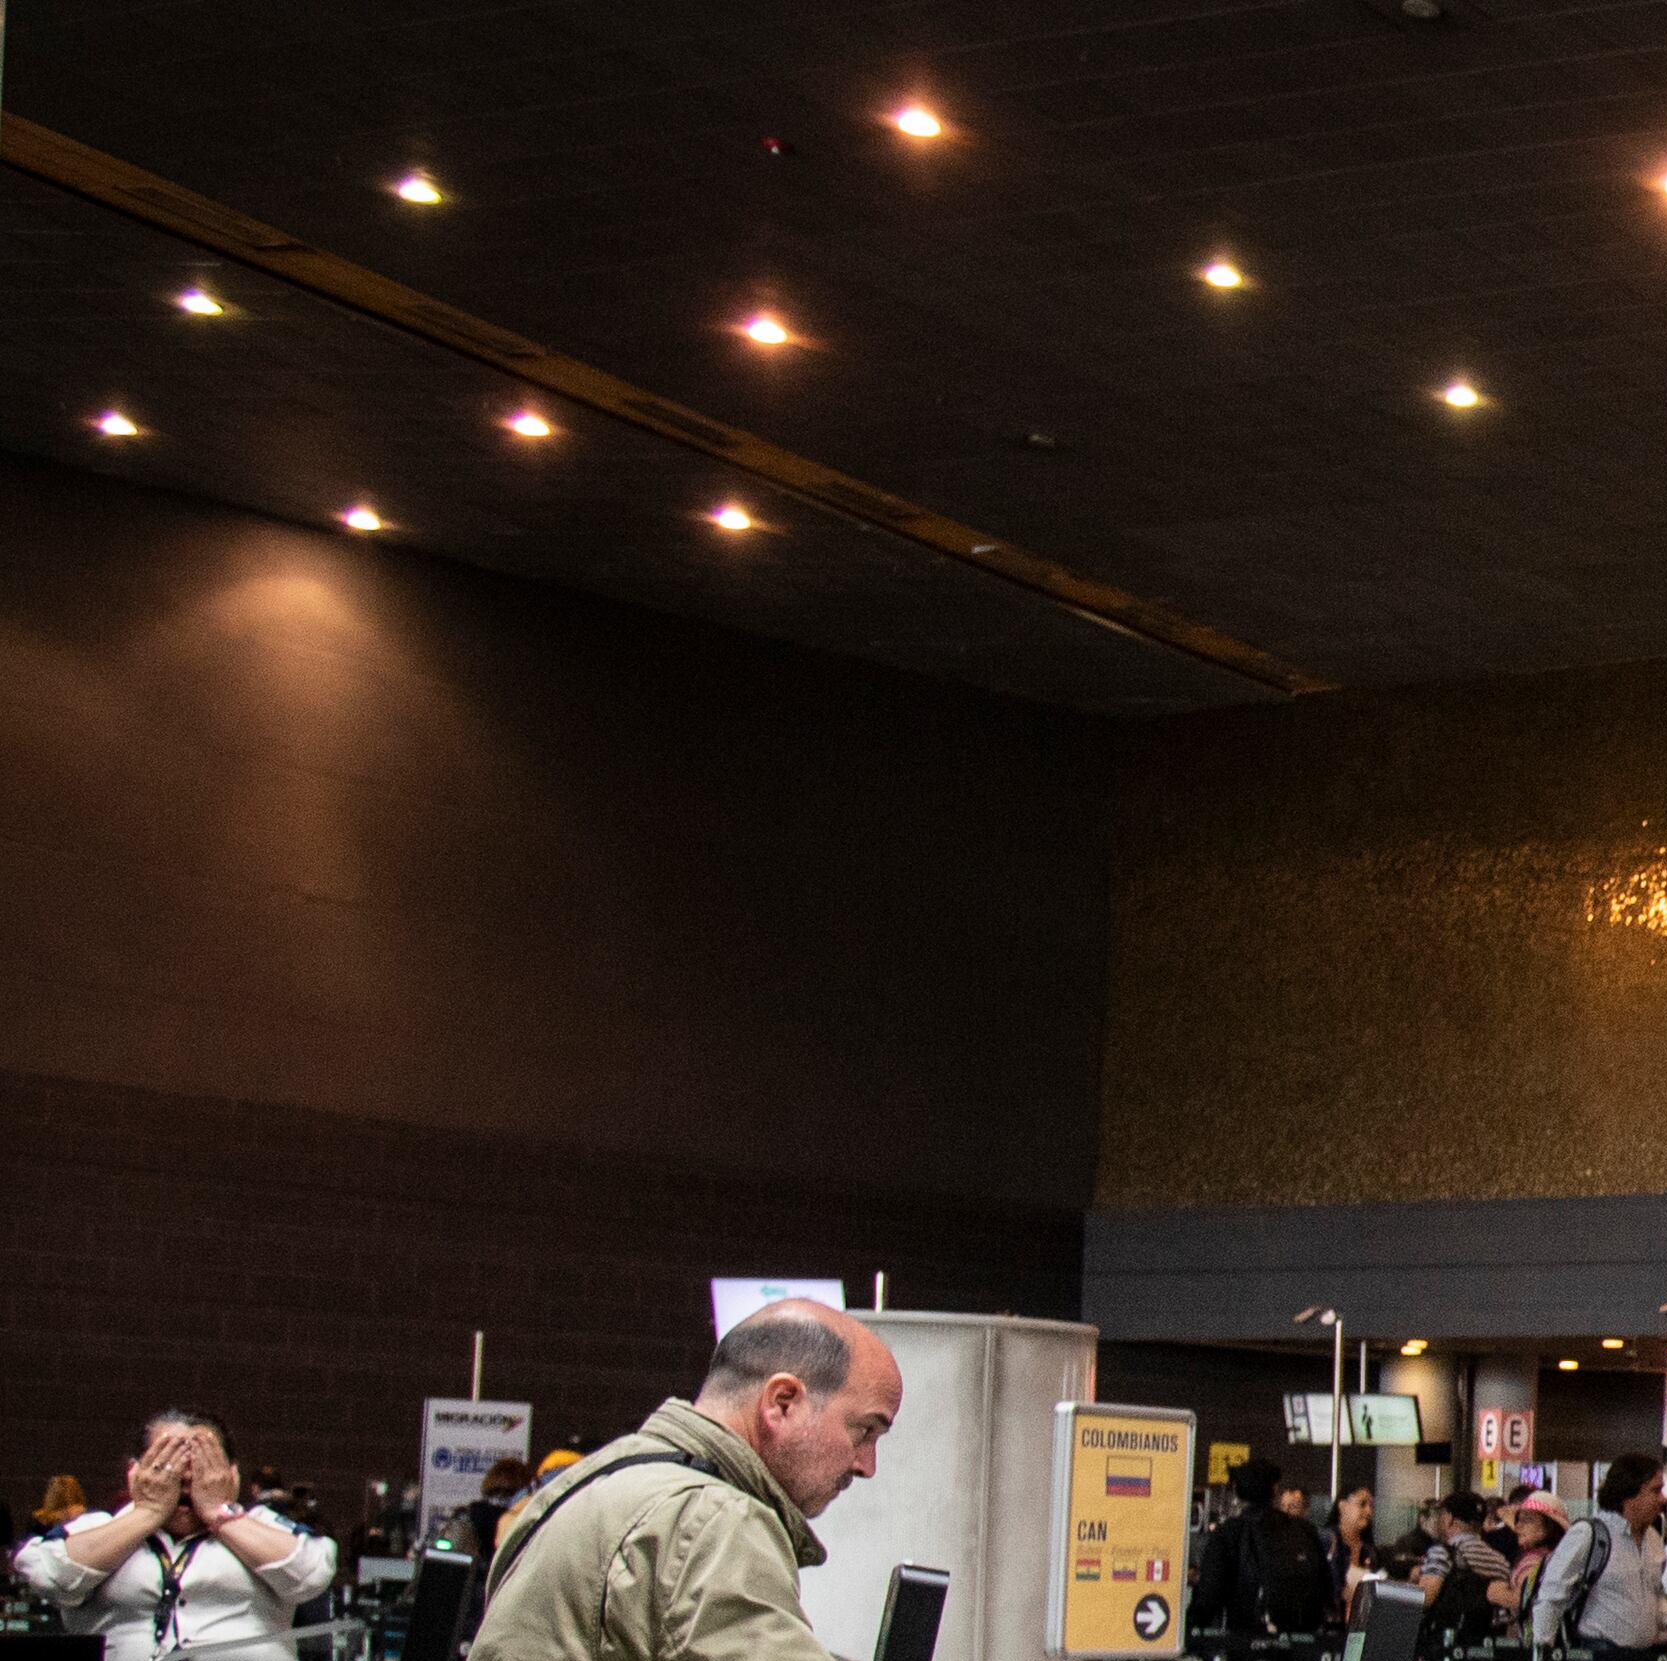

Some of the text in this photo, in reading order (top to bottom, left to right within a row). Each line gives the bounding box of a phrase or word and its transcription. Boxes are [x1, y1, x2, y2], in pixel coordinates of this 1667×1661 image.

[1081, 1428, 1178, 1452] COLOMBIANOS
[1509, 1419, 1521, 1448] E
[1077, 1520, 1107, 1541] CAN
